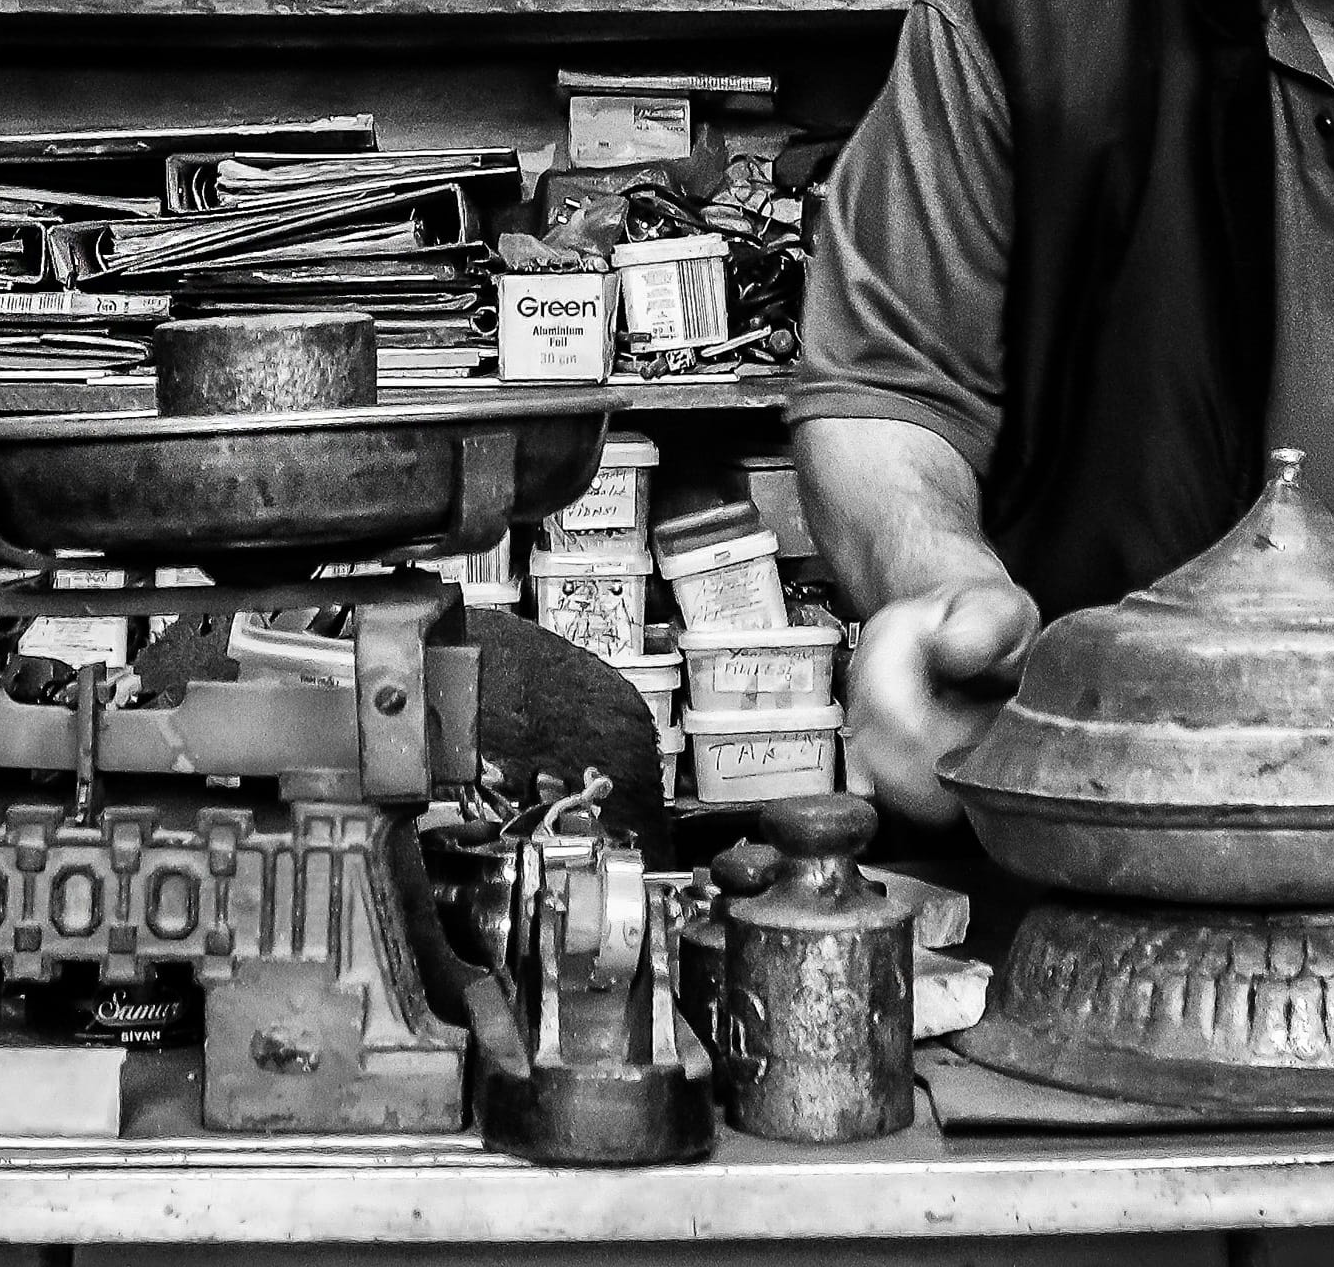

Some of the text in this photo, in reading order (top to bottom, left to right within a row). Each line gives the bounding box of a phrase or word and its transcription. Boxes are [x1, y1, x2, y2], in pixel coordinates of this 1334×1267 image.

[517, 296, 597, 318] Green
[532, 325, 584, 336] Aluminium
[549, 336, 568, 348] Foil
